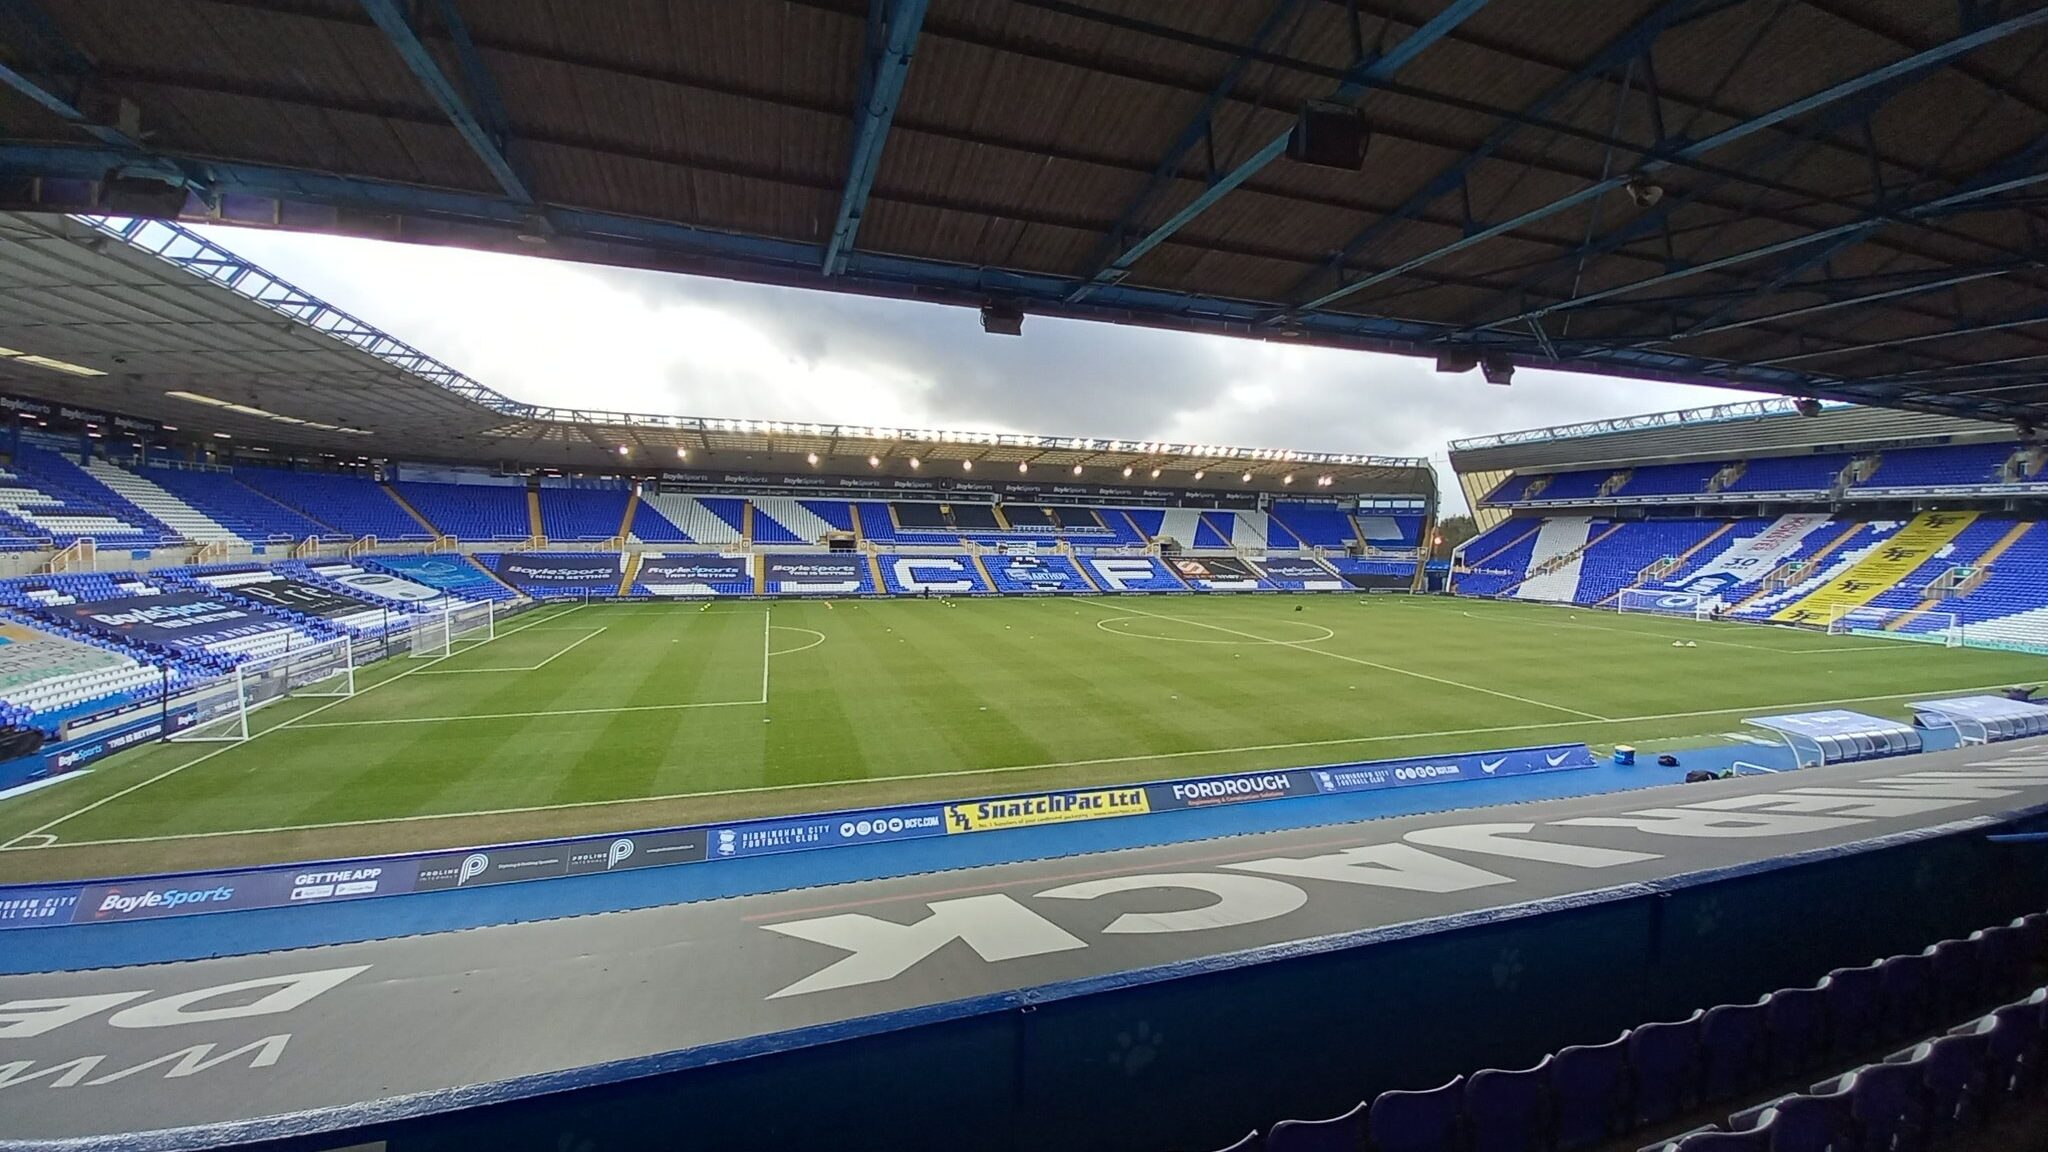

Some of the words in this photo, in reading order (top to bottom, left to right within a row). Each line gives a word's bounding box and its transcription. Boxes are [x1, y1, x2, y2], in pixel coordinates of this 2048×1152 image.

[508, 564, 613, 575] BoyleSports
[647, 565, 739, 575] BoyleSports
[772, 564, 855, 574] BoyleSports
[90, 601, 227, 626] BoyleSports
[126, 734, 133, 743] IS
[133, 725, 161, 740] BETTING
[58, 743, 102, 767] BoyleSports
[1173, 774, 1290, 800] FORDROUGH
[977, 793, 1104, 820] SnatchPac
[1108, 791, 1142, 807] Ltd
[905, 816, 940, 829] BCFC.COM
[742, 828, 804, 841] BIRMINGHAM
[808, 825, 830, 835] CITY
[742, 837, 791, 849] FOOTBALL
[795, 834, 819, 843] CLUB
[572, 852, 608, 861] PROLINE
[352, 868, 382, 881] APP
[420, 868, 459, 877] PROLINE
[46, 896, 77, 907] CITY
[99, 886, 235, 913] BoyleSports
[23, 907, 56, 918] CLUB
